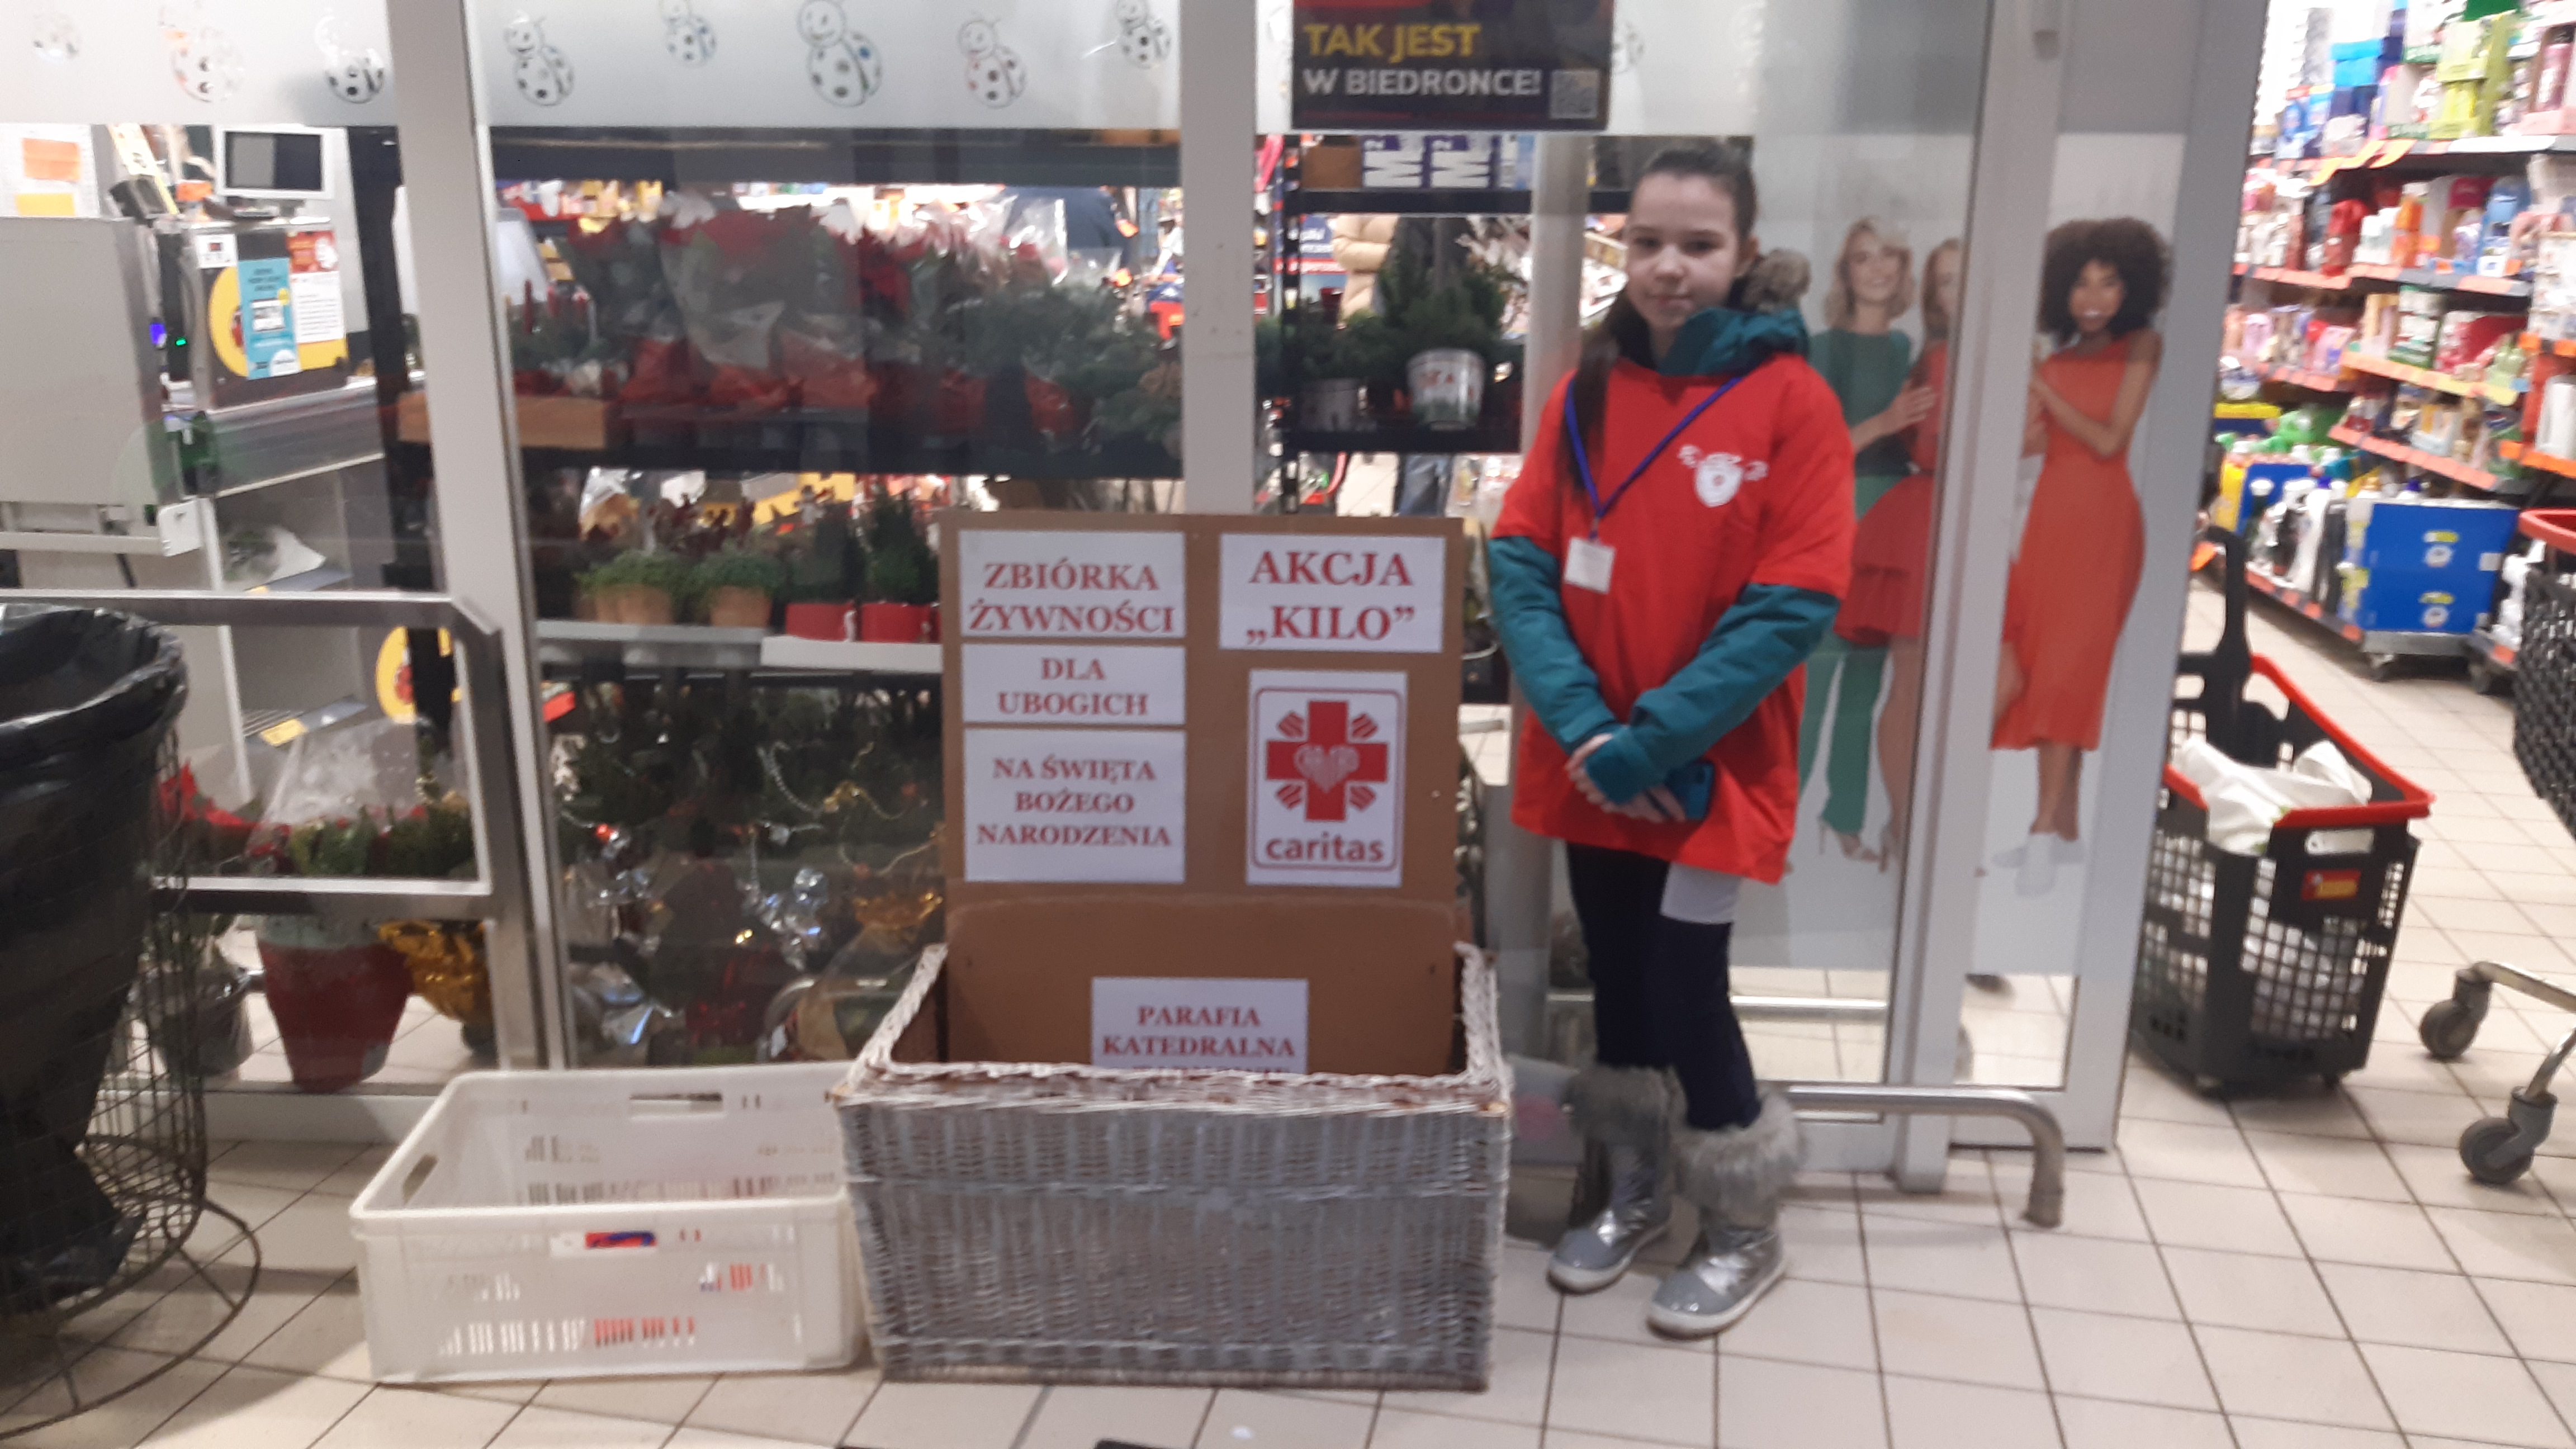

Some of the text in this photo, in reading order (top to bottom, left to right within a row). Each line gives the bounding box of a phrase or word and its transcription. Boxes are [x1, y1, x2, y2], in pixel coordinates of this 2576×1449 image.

[1303, 23, 1481, 63] TAK JEST
[1303, 68, 1542, 95] W BIEDRONCE!
[985, 556, 1159, 590] ZBIÓRKA
[1249, 550, 1413, 587] AKCJA
[969, 598, 1175, 633] ŻYWNOŚCI
[1041, 657, 1106, 681] DLA
[998, 692, 1148, 716] UBOGICH
[993, 753, 1156, 785] NA ŚWIĘTA
[1015, 786, 1135, 813] BOŻEGO
[977, 824, 1172, 846] NARODZENIA
[1265, 831, 1385, 864] caritas
[1138, 1006, 1261, 1027] PARAFIA
[1102, 1036, 1295, 1057] KATEDRALNA
